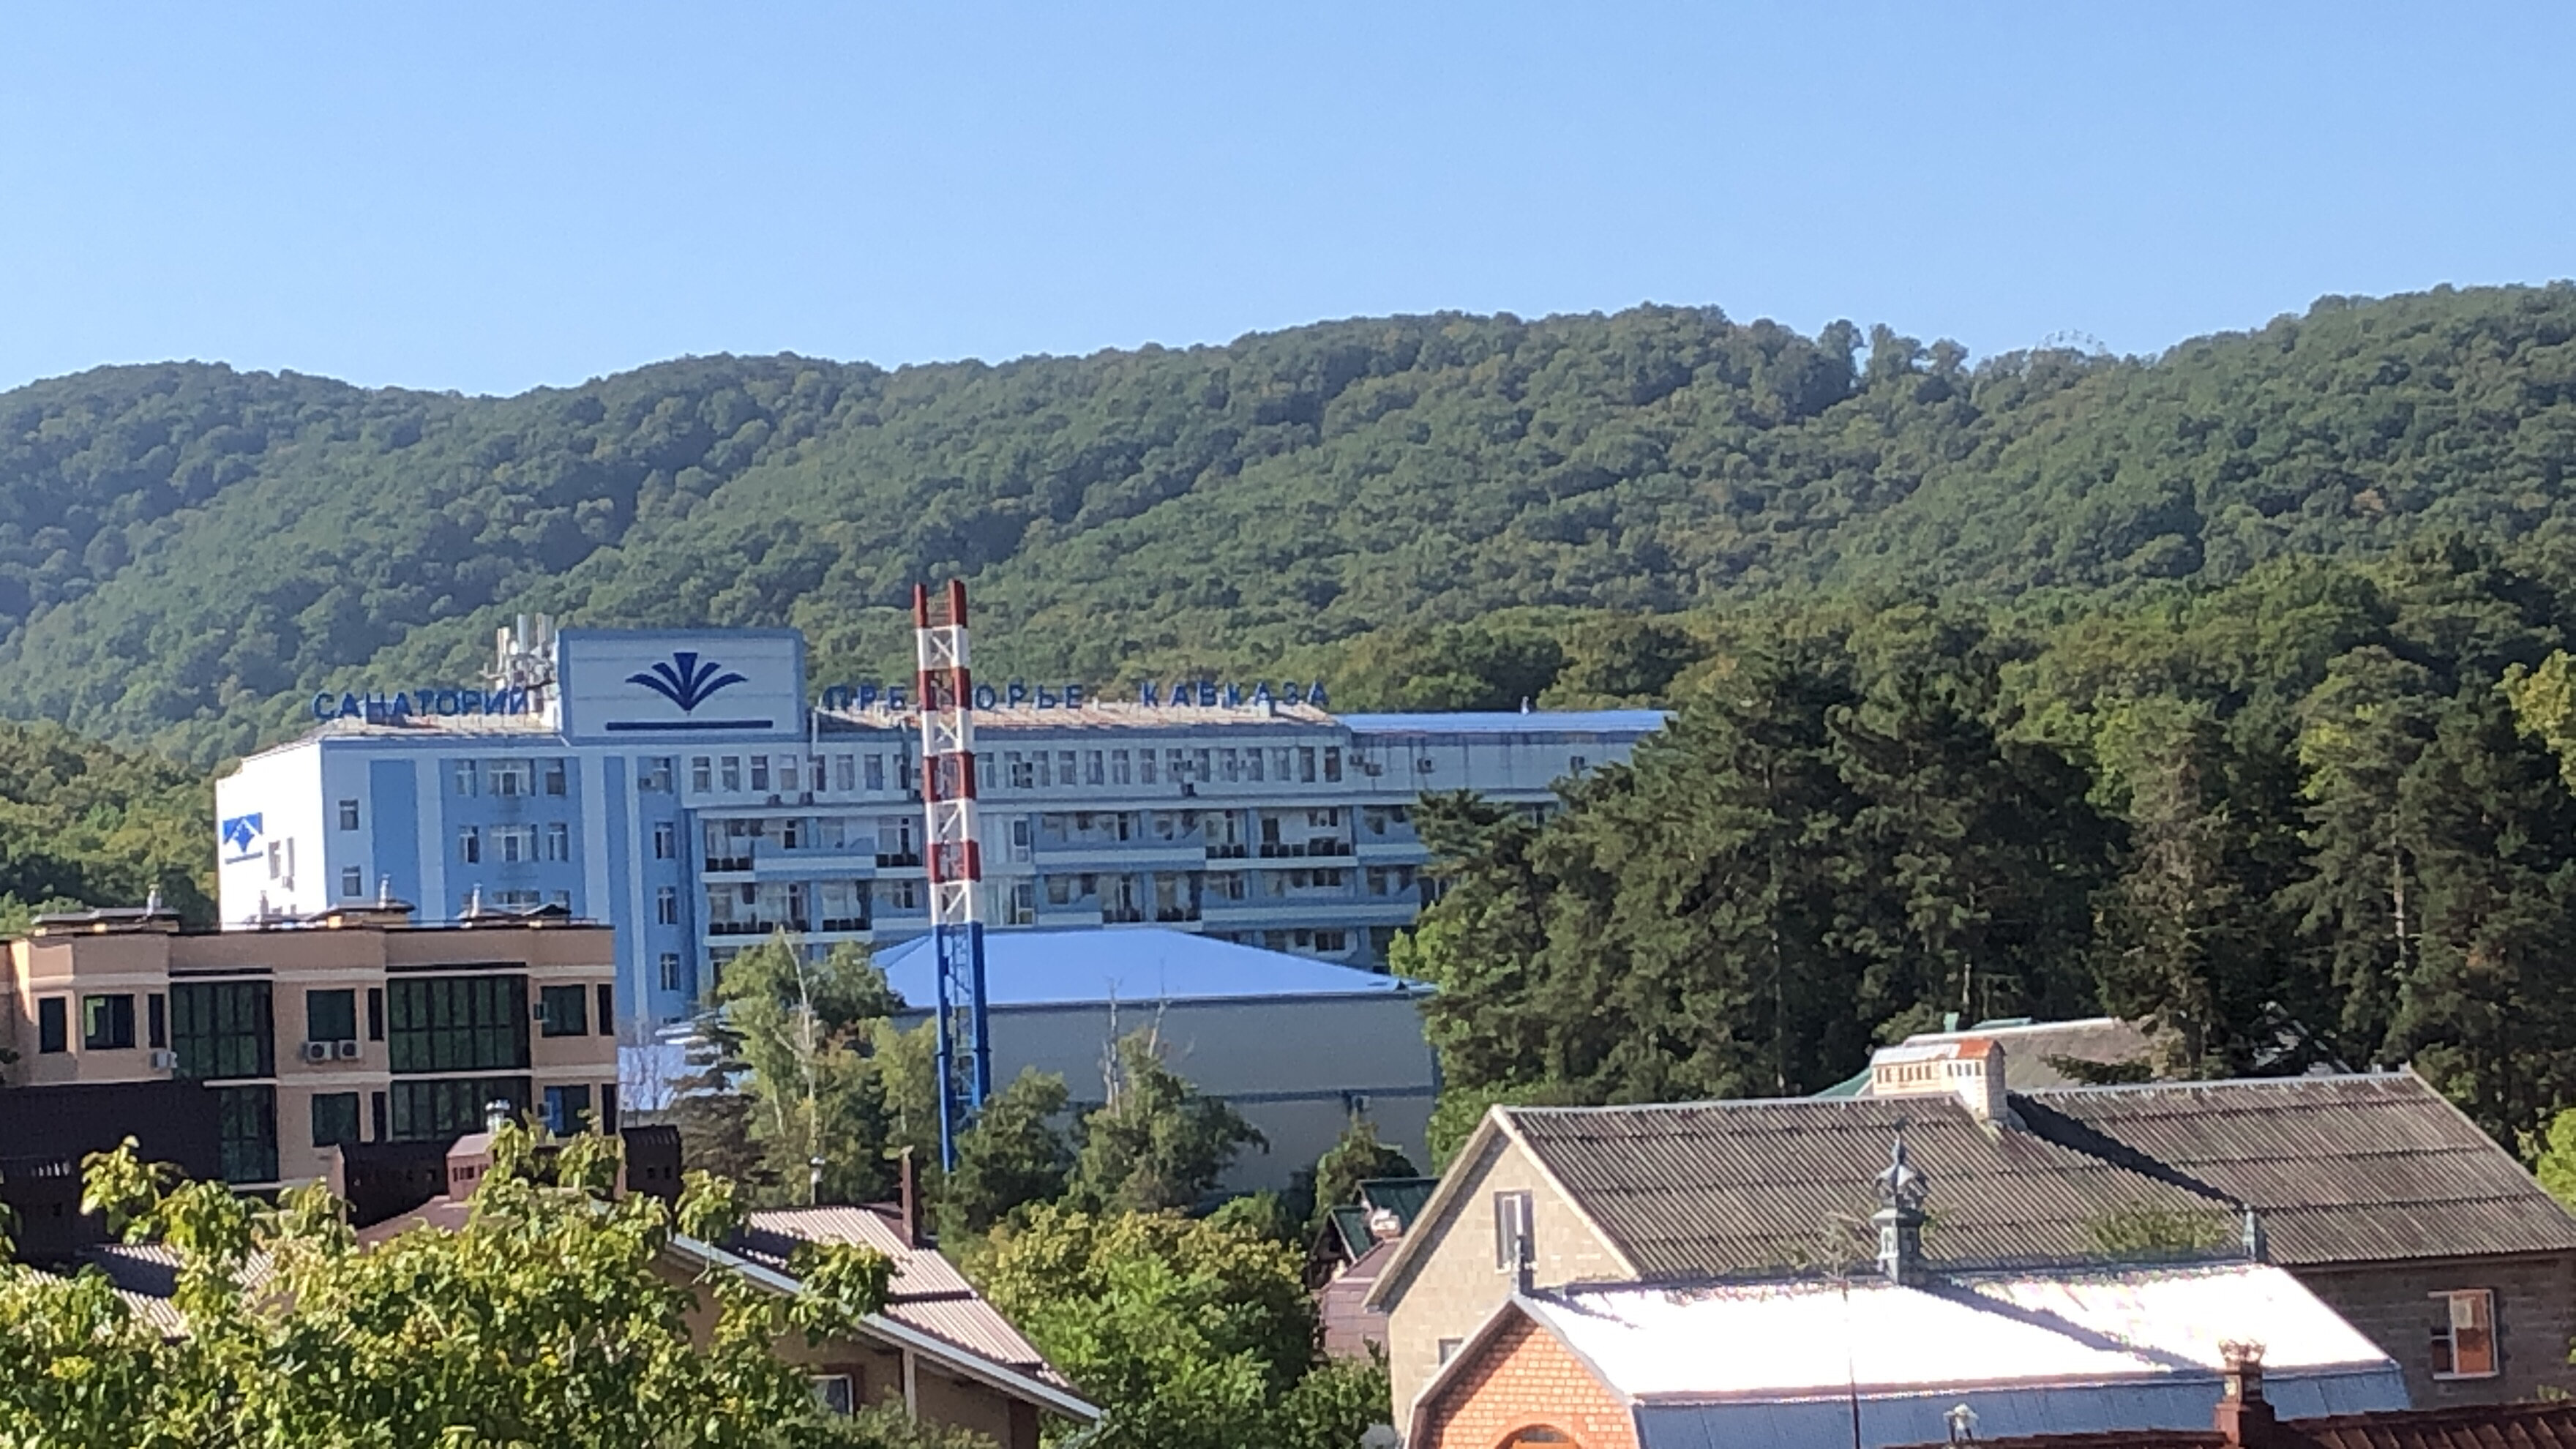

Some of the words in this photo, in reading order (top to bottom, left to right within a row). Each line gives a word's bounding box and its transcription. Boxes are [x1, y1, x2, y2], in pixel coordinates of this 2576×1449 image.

[312, 685, 529, 719] САНАТОРИЙ
[823, 682, 1083, 711] ПРЕОРЬЕ
[1141, 681, 1330, 708] КАВКАЗА
